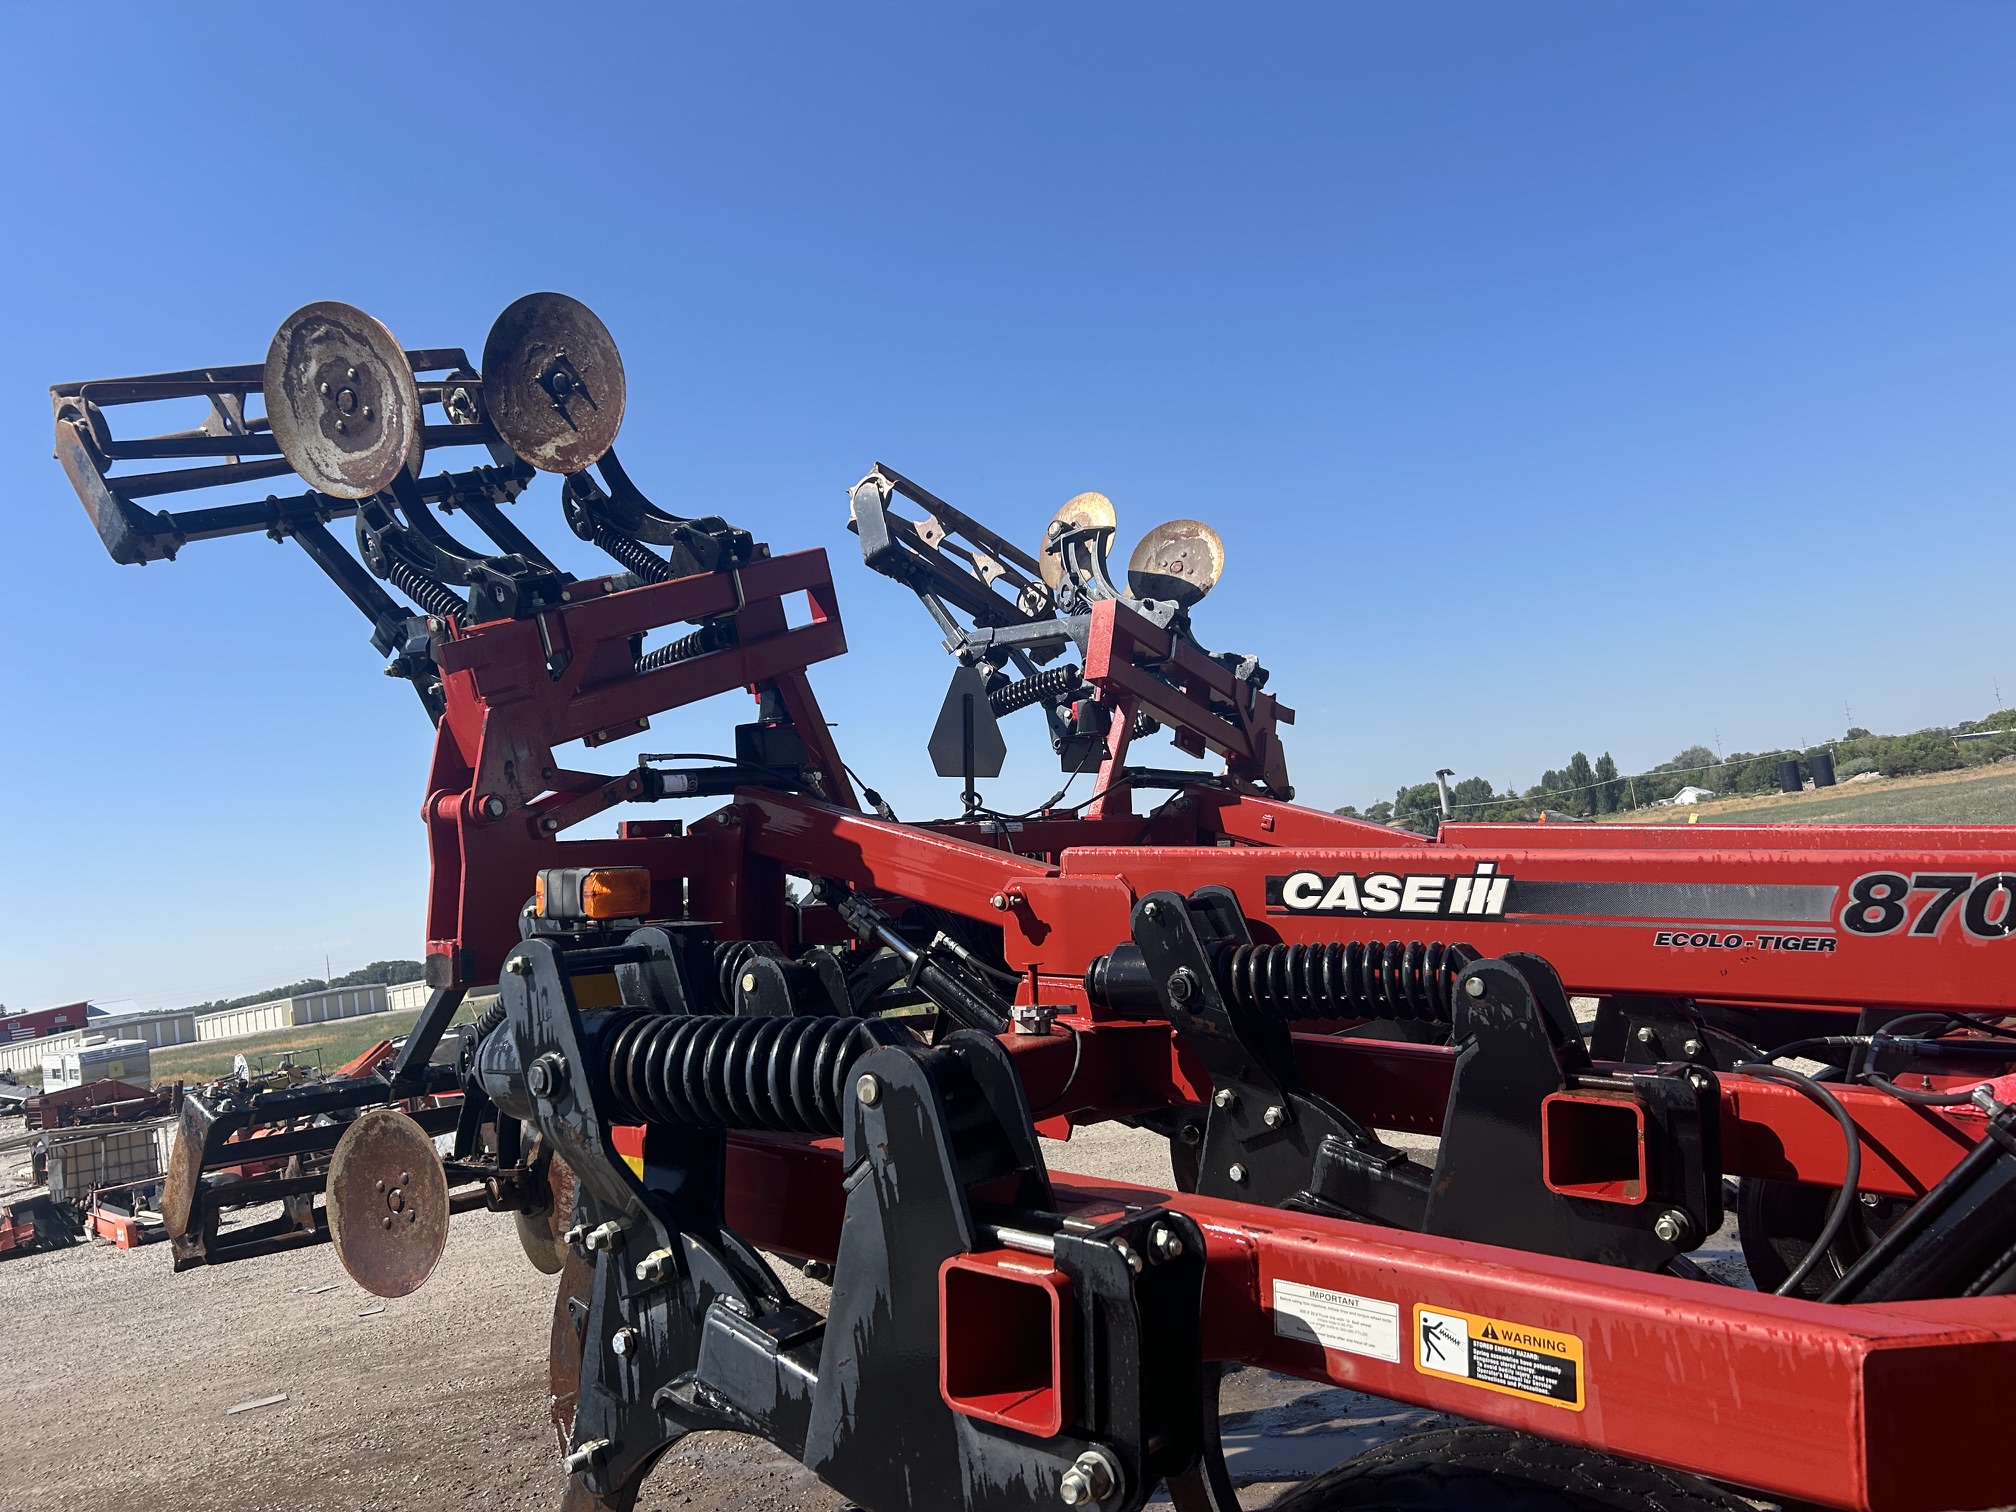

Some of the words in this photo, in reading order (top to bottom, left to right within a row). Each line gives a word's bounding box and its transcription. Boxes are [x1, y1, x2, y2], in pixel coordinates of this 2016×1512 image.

[1282, 872, 1446, 913] CASE
[1840, 871, 2016, 939] 870
[1654, 931, 1839, 952] ECOLO-TIGER
[1309, 1290, 1360, 1307] IMPORTANT
[1473, 1340, 1493, 1350] STORED
[1494, 1345, 1514, 1355] ENERGY
[1501, 1329, 1566, 1353] WARNING
